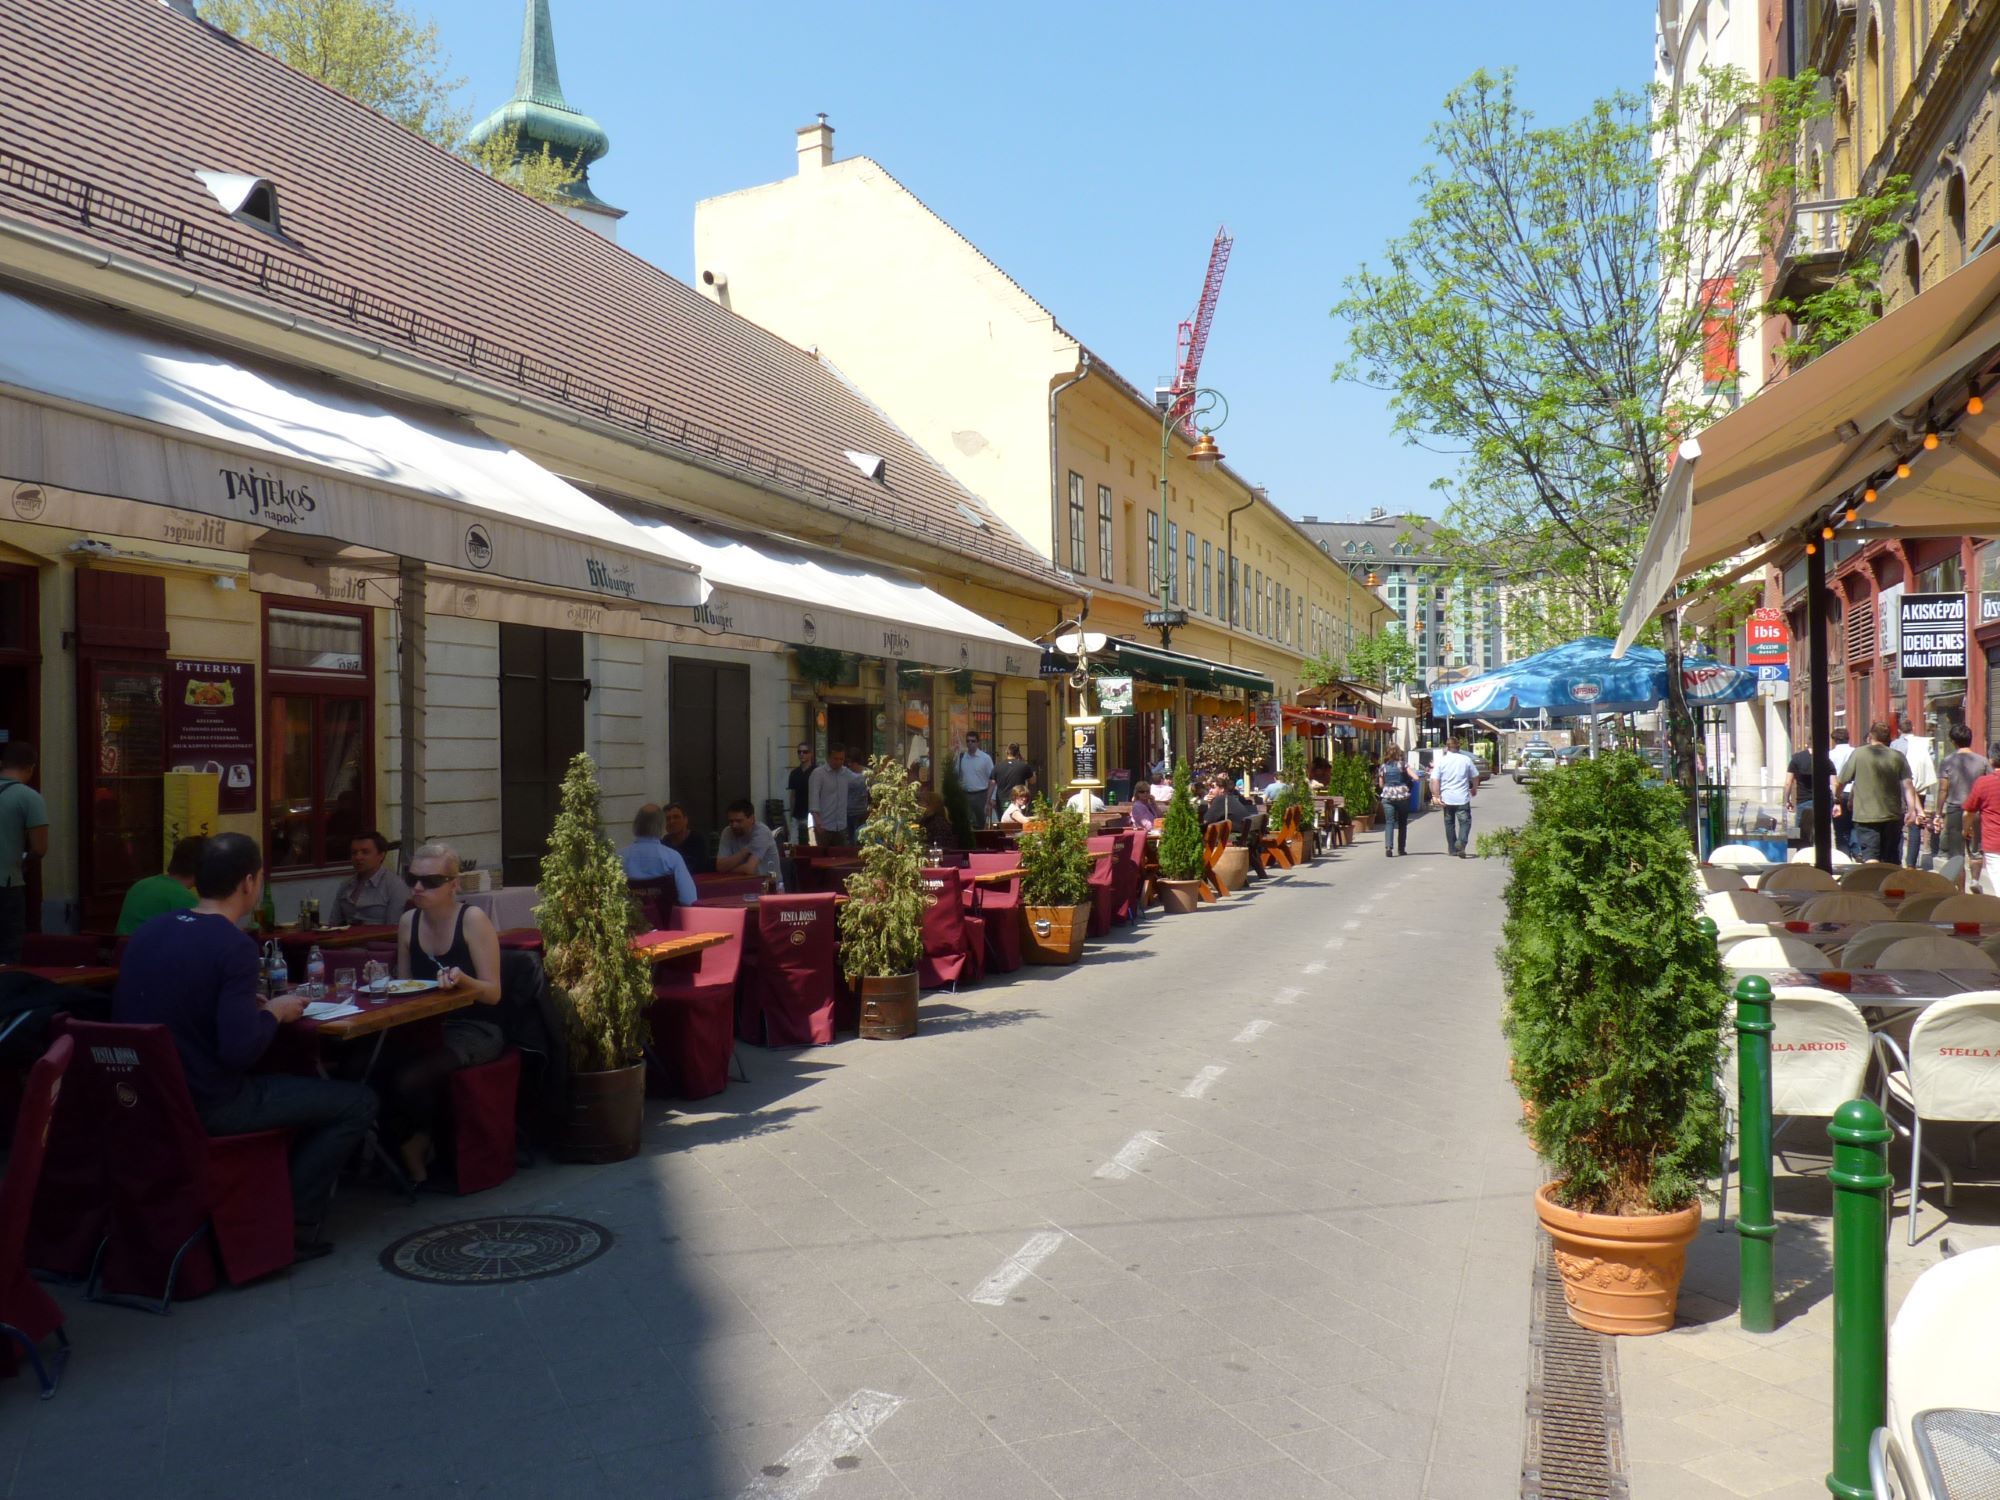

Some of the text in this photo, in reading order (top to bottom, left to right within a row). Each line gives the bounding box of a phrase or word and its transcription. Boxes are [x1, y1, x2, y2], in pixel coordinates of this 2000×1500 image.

[264, 510, 297, 526] napok
[586, 557, 637, 597] Bitburger
[1902, 600, 1964, 620] A KISKÉPZŐ
[1754, 625, 1781, 638] ibis
[1903, 633, 1964, 651] IDEIGLENES
[1903, 651, 1964, 667] KIÁLLÍTÓTERE
[175, 661, 241, 674] ÉTTEREM
[1762, 668, 1772, 679] P
[1770, 1042, 1847, 1052] LLA ARTOIS
[1939, 1047, 1990, 1057] STELLA
